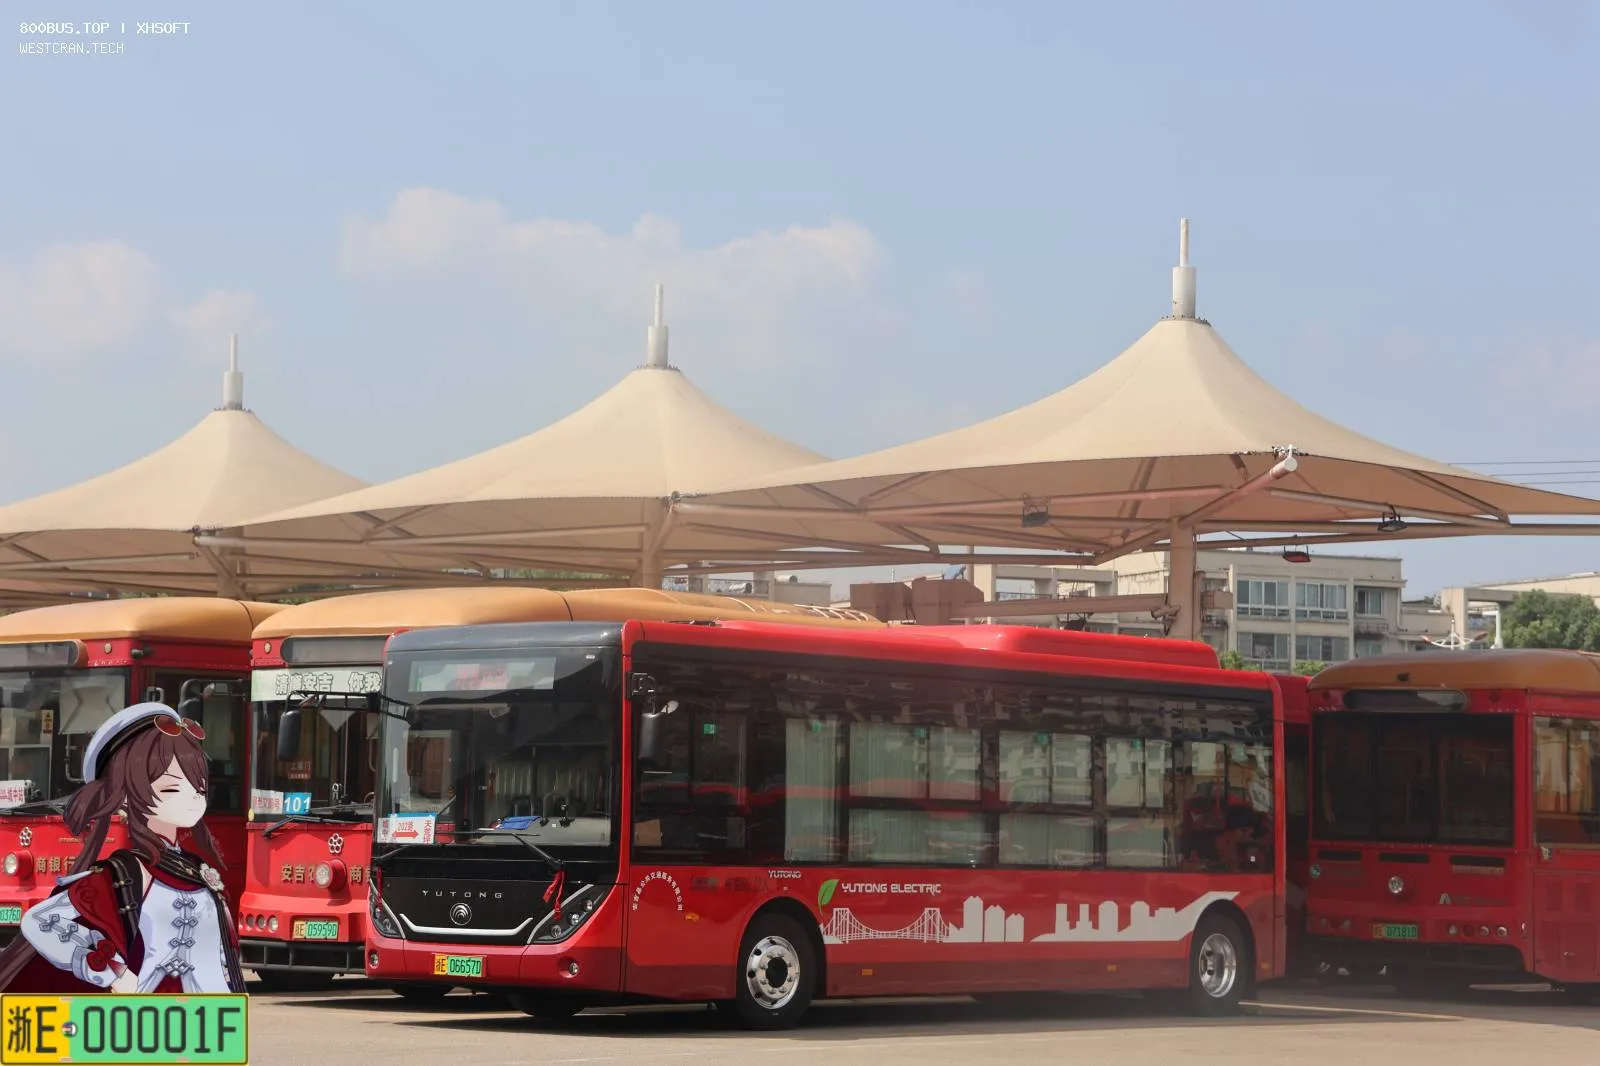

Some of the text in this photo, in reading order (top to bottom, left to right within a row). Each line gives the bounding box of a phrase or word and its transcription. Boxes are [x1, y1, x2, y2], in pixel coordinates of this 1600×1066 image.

[284, 796, 311, 813] 101
[768, 870, 802, 879] YUTONG
[841, 883, 888, 894] YUTONG
[422, 890, 503, 899] YUTONG
